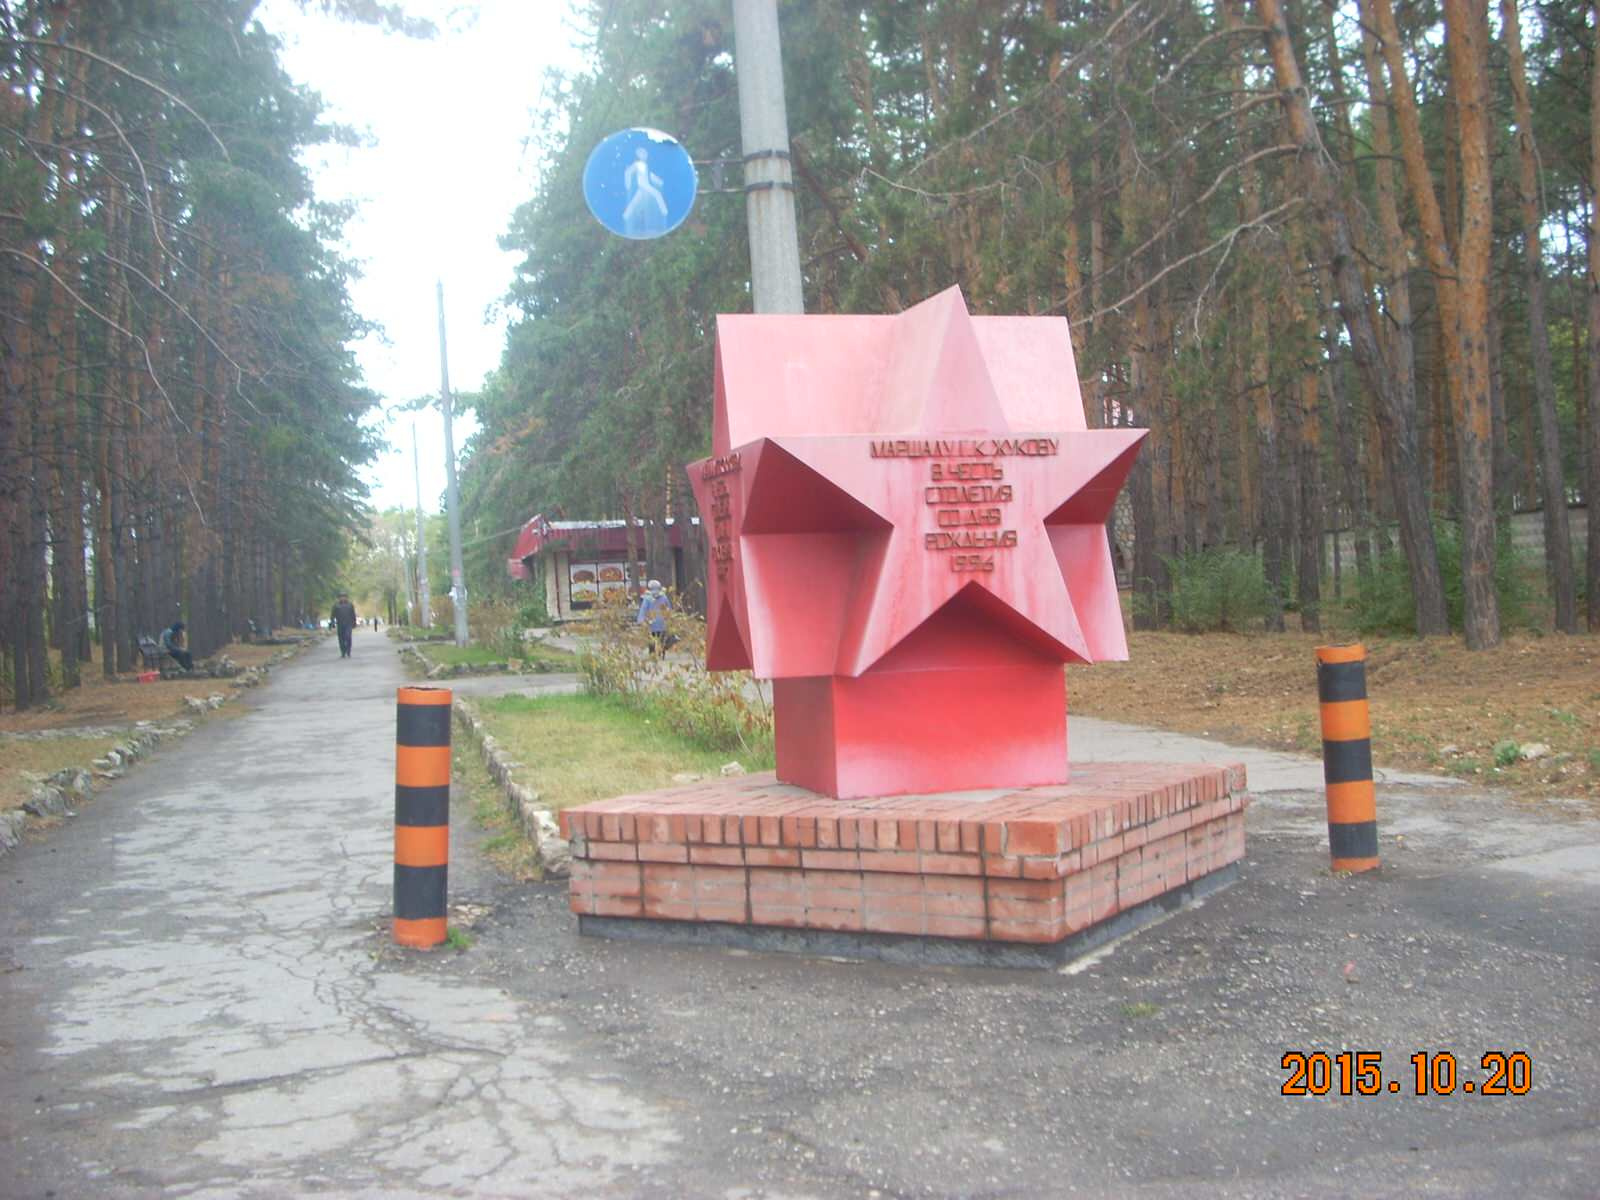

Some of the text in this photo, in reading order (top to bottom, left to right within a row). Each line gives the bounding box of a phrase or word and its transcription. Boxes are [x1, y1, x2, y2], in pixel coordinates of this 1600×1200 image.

[992, 439, 1059, 457] ЖУКОВУ
[931, 463, 1003, 481] В ЧЕСТЬ
[925, 485, 1013, 504] СТОЛЕТИЯ
[938, 508, 1001, 528] СО ДНЯ
[925, 530, 1017, 550] РОЖДЕНИЯ
